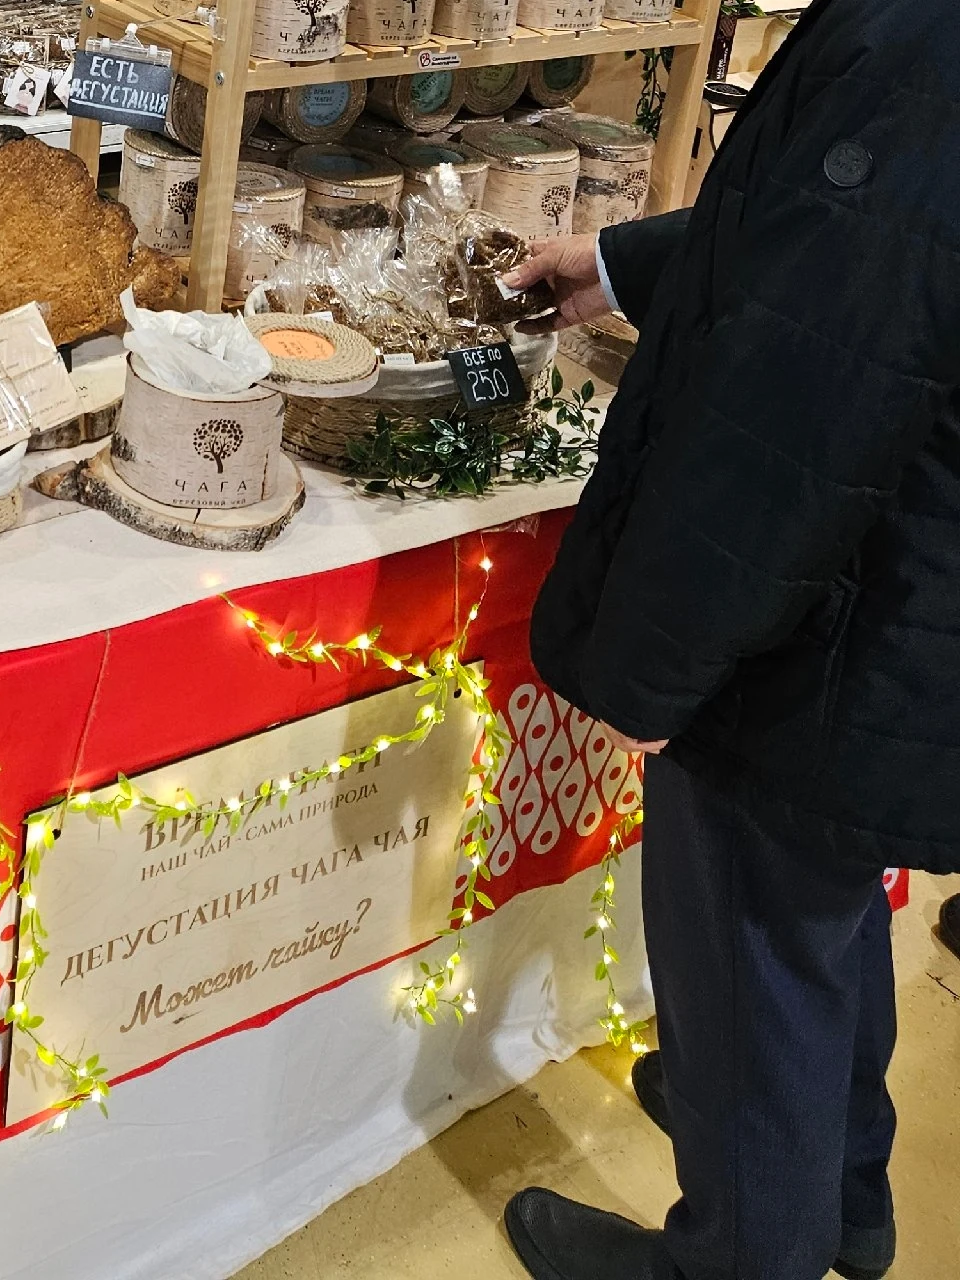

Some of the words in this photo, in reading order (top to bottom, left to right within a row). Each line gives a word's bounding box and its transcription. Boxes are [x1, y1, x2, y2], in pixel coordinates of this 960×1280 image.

[383, 19, 427, 31] ЧАГА
[477, 10, 511, 21] ЧАГ
[90, 55, 139, 84] ЕСТЬ
[70, 77, 169, 115] ДЕГУСТАЦИЯ
[155, 227, 193, 239] ЧАГ
[466, 368, 510, 402] 250
[174, 479, 247, 493] ЧАГА
[141, 852, 189, 883] НАШ
[193, 834, 233, 867] ЧАЙ
[245, 813, 295, 842] САМА
[299, 782, 380, 822] ПРИРОДА
[60, 873, 280, 988] ДЕГУСТАЦИЯ
[290, 847, 364, 886] ЧАГА
[374, 815, 432, 853] ЧАЯ
[120, 959, 259, 1034] Может
[260, 896, 373, 974] чайку?
